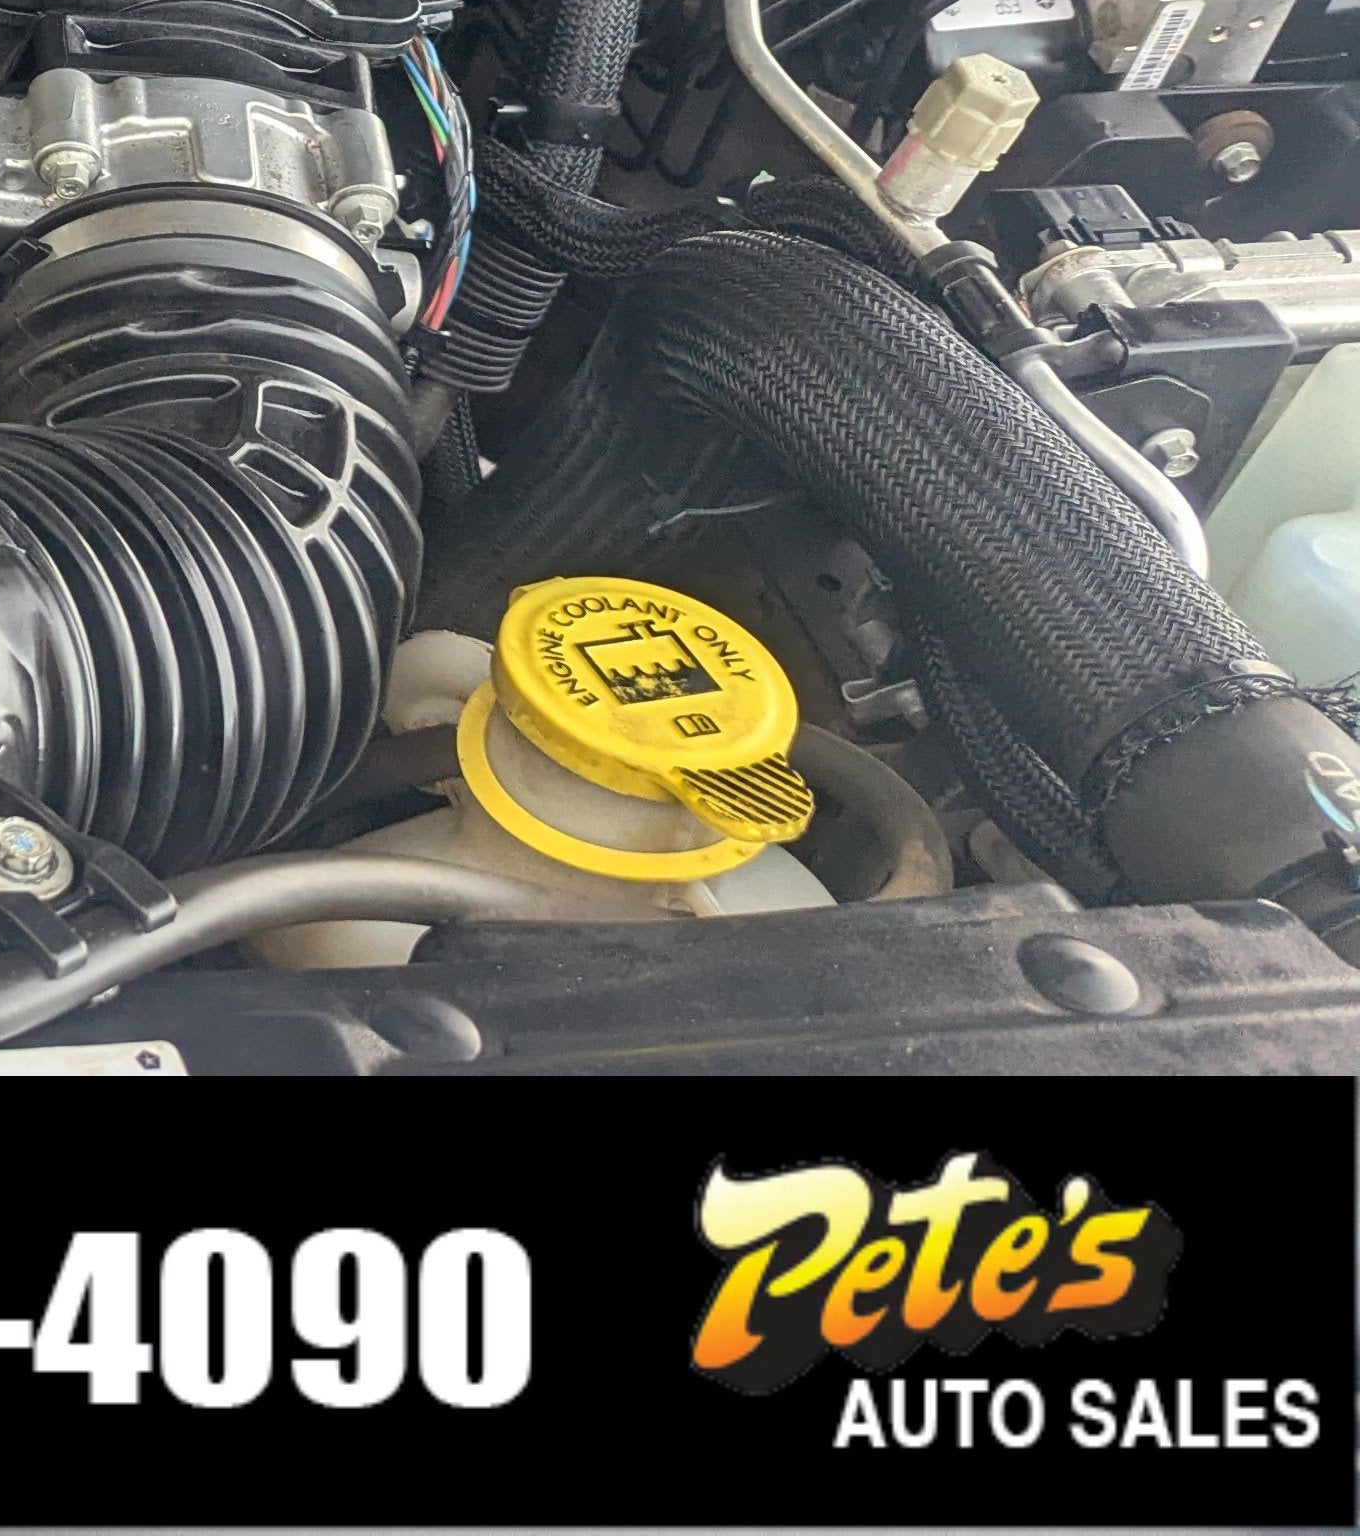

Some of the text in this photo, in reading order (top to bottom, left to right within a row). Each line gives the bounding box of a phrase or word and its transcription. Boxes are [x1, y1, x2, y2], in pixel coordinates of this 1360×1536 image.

[538, 595, 756, 708] ENGINE COOLANT ONLY
